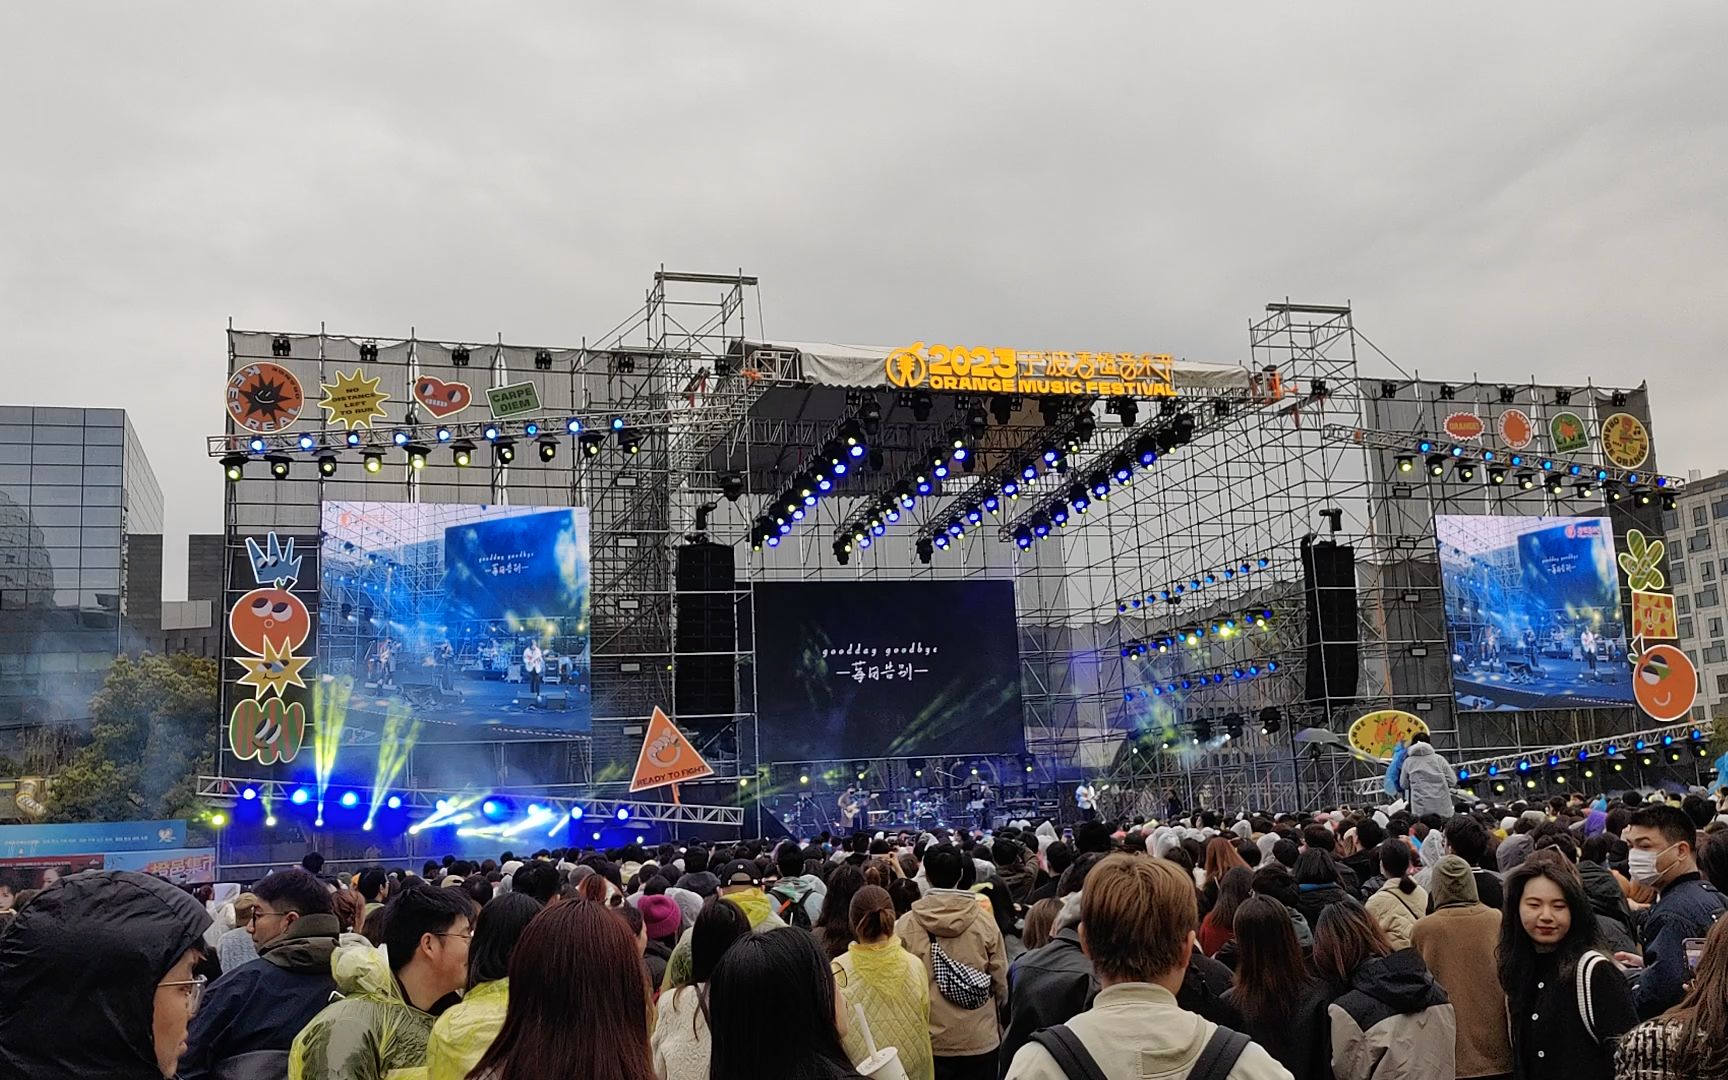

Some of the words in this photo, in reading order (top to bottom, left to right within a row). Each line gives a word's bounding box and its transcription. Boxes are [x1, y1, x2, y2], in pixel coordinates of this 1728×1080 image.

[928, 344, 1017, 378] 2023
[332, 392, 377, 402] DISTANCE
[492, 387, 532, 402] CARPE
[930, 376, 1014, 393] ORANGE
[1018, 380, 1082, 395] MUSIC
[1085, 381, 1178, 397] FESTIVAL
[227, 365, 261, 415] KEEP
[244, 406, 300, 431] REAL
[500, 399, 531, 412] DIEM
[1603, 416, 1620, 457] ORANGE
[1616, 443, 1647, 467] ORANGE
[822, 643, 877, 658] goodday
[885, 642, 938, 657] goodbye
[1352, 720, 1372, 754] ORANGE
[636, 774, 666, 786] READY
[668, 771, 679, 779] TO
[681, 765, 706, 777] FIGHT
